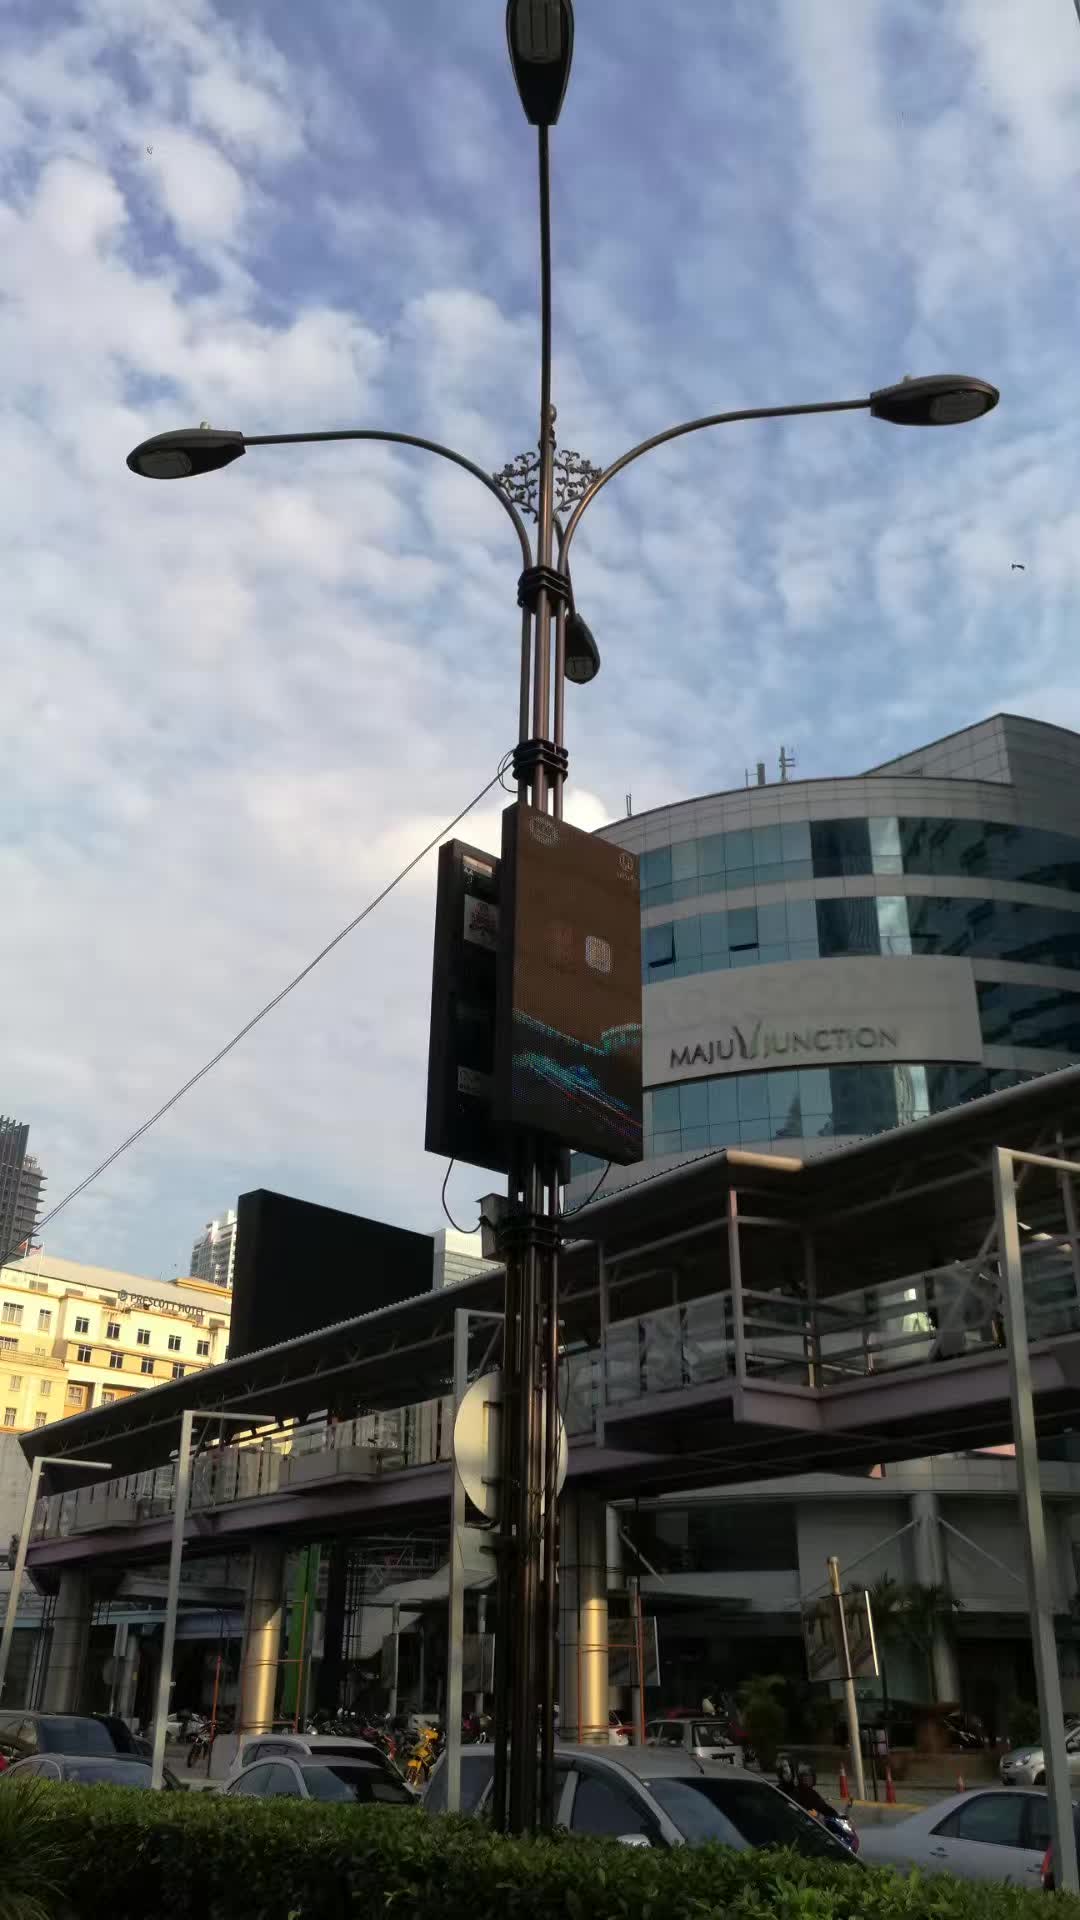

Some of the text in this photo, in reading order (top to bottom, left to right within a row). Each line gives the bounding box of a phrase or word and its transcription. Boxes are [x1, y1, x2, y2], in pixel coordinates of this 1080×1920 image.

[670, 1038, 734, 1068] MAJU
[131, 1294, 204, 1316] PRESCOTT HOTEL
